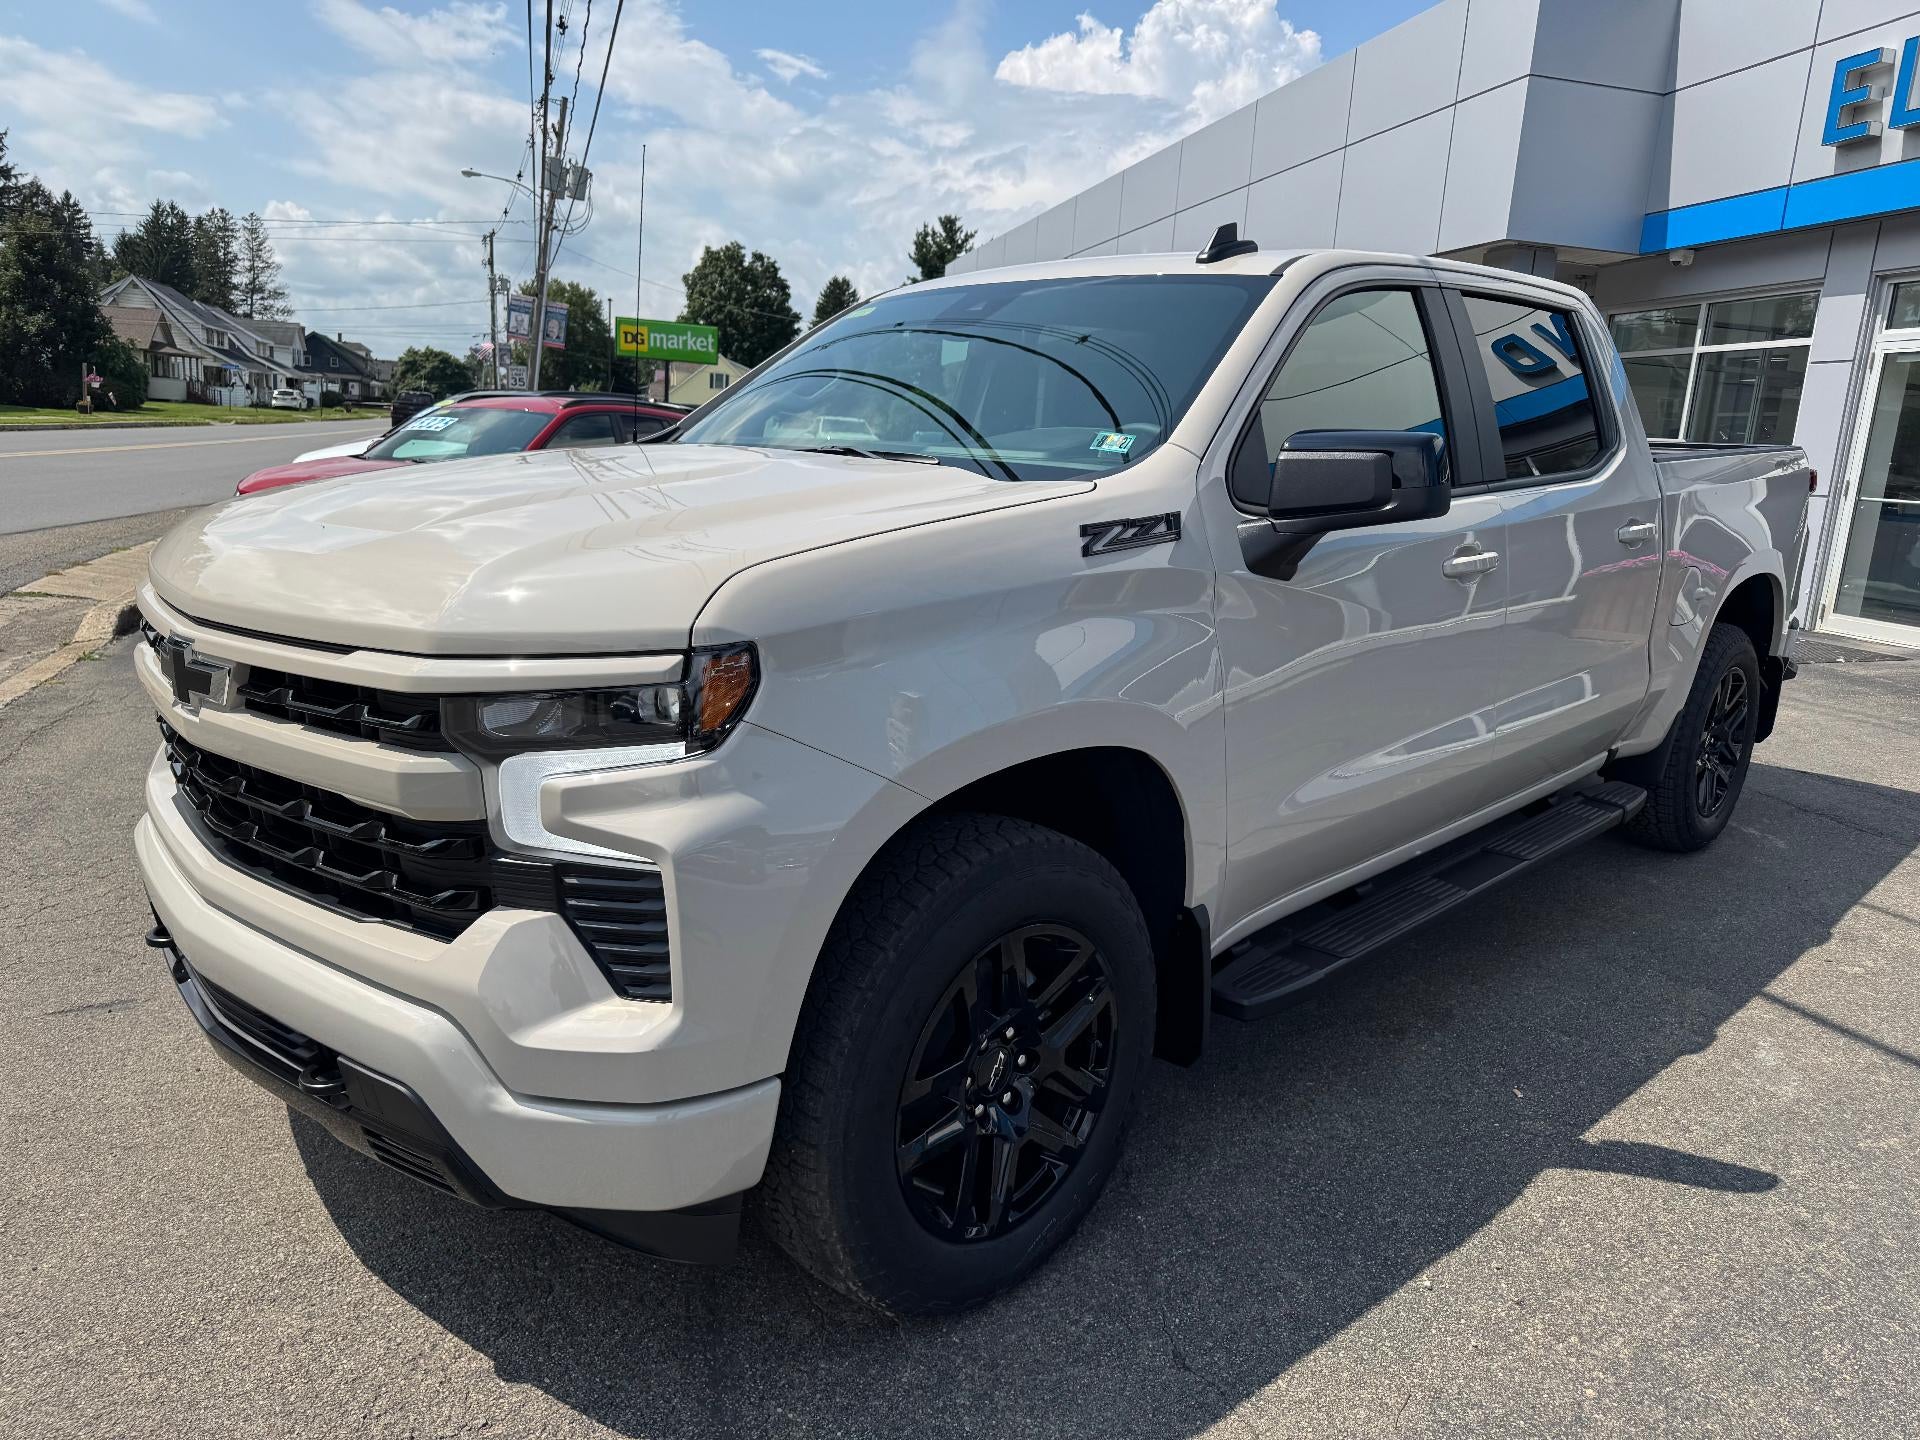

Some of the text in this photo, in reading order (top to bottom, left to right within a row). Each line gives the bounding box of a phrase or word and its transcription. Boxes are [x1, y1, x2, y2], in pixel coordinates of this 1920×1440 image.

[623, 331, 715, 352] DG market
[511, 377, 526, 387] 35
